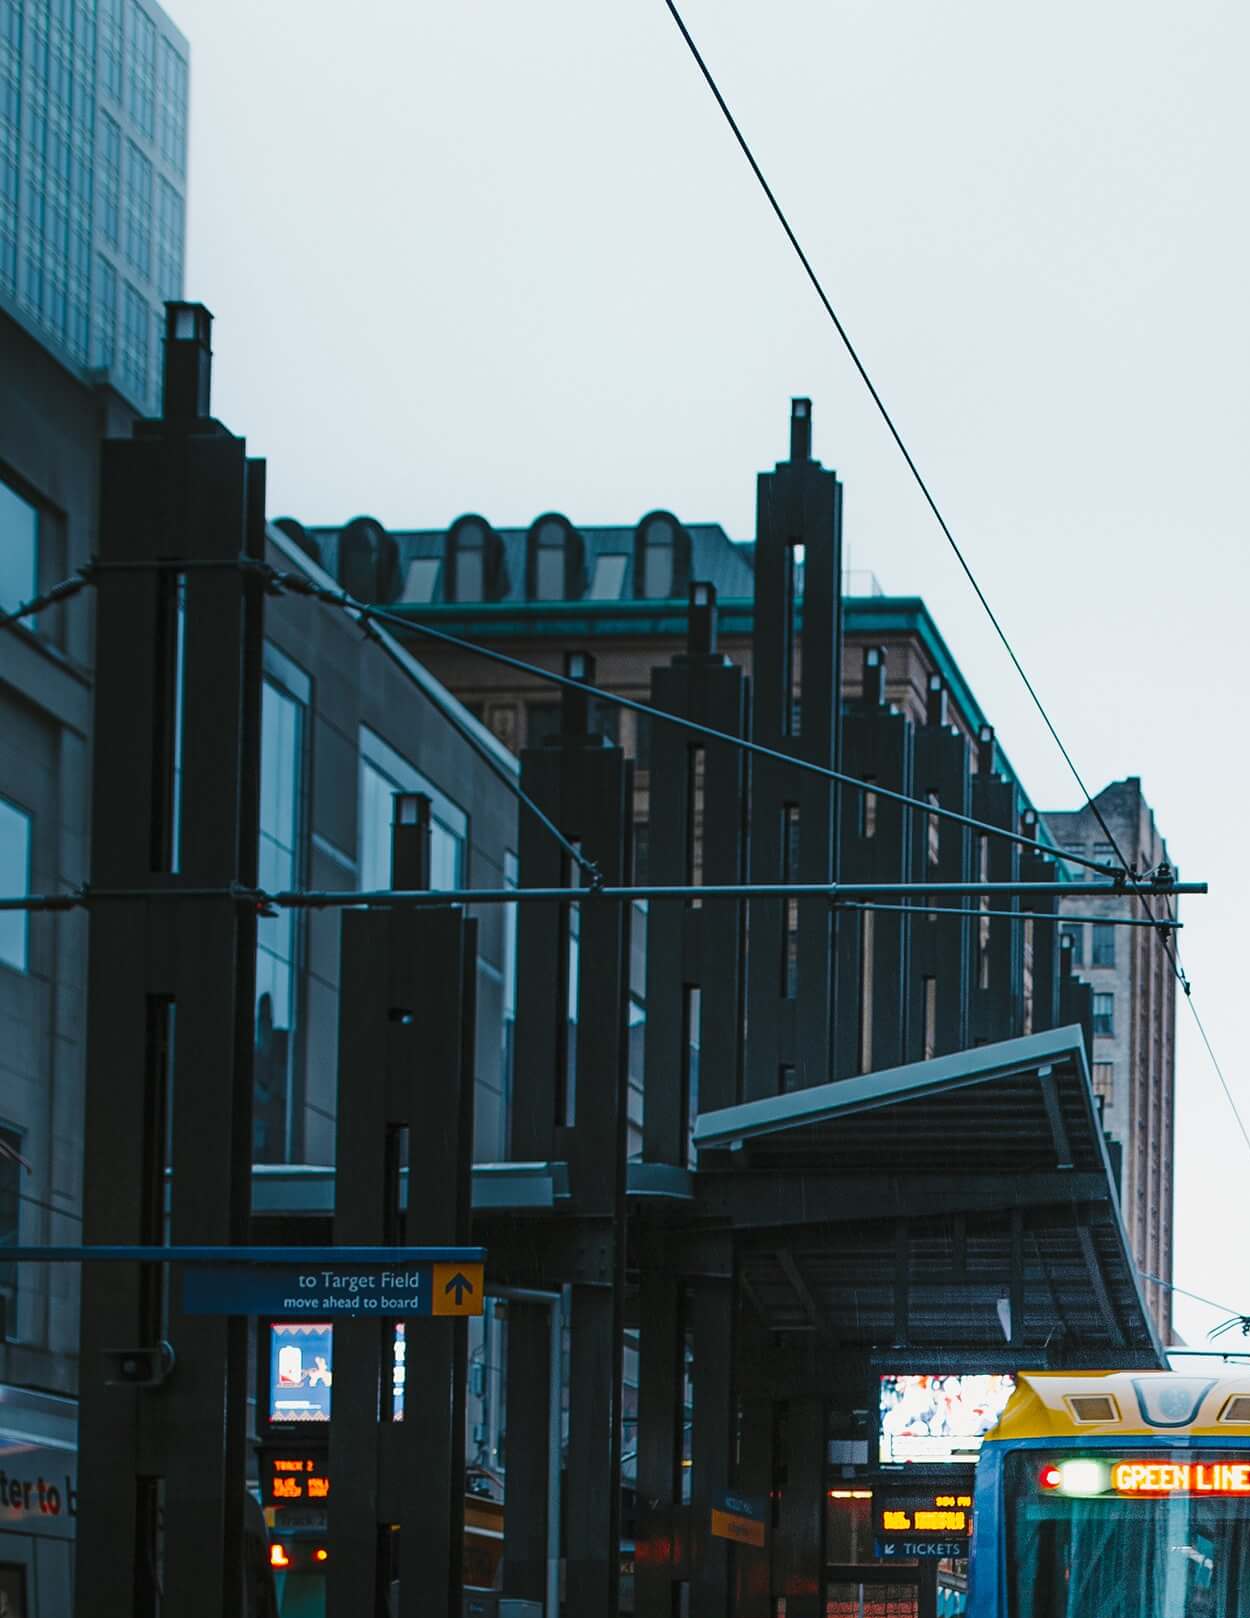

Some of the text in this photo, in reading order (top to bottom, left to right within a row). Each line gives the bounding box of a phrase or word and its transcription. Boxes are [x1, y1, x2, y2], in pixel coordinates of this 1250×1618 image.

[298, 1271, 419, 1292] to Target Field
[283, 1295, 418, 1308] move ahead to board
[1116, 1464, 1190, 1491] GREEN
[37, 1477, 60, 1516] to
[903, 1543, 960, 1555] TICKETS
